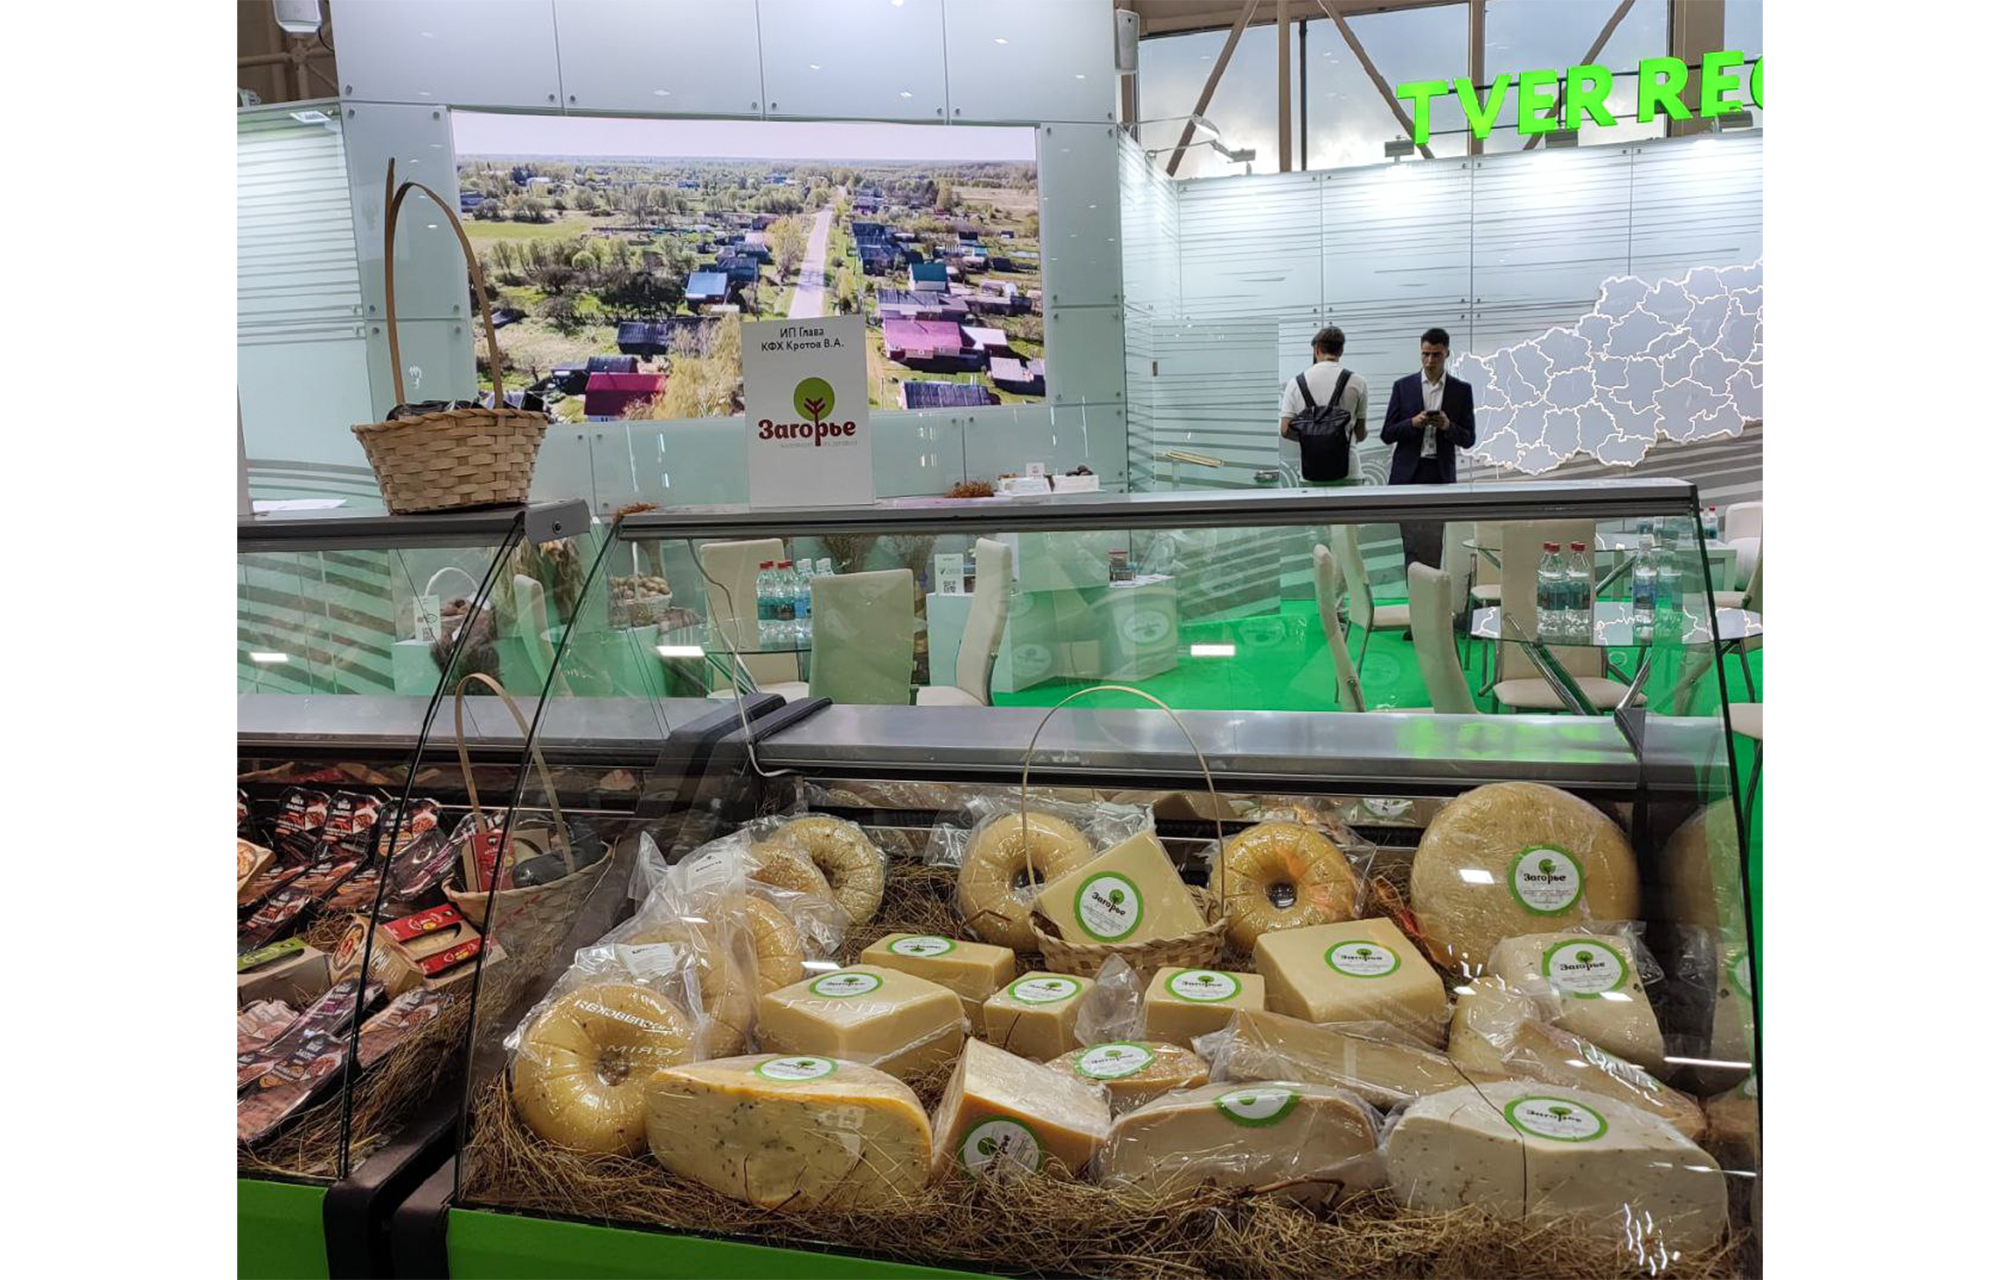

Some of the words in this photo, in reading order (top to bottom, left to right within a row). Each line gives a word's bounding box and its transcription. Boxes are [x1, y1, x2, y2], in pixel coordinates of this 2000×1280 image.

[1396, 64, 1618, 145] TVER
[780, 327, 796, 338] ИП
[799, 327, 824, 338] Глава
[761, 341, 784, 352] КФХ
[786, 340, 821, 352] Кротов
[824, 338, 845, 349] В.А.
[758, 419, 856, 446] Загорье
[1524, 873, 1566, 884] Загорье
[1091, 891, 1126, 915] Загорье
